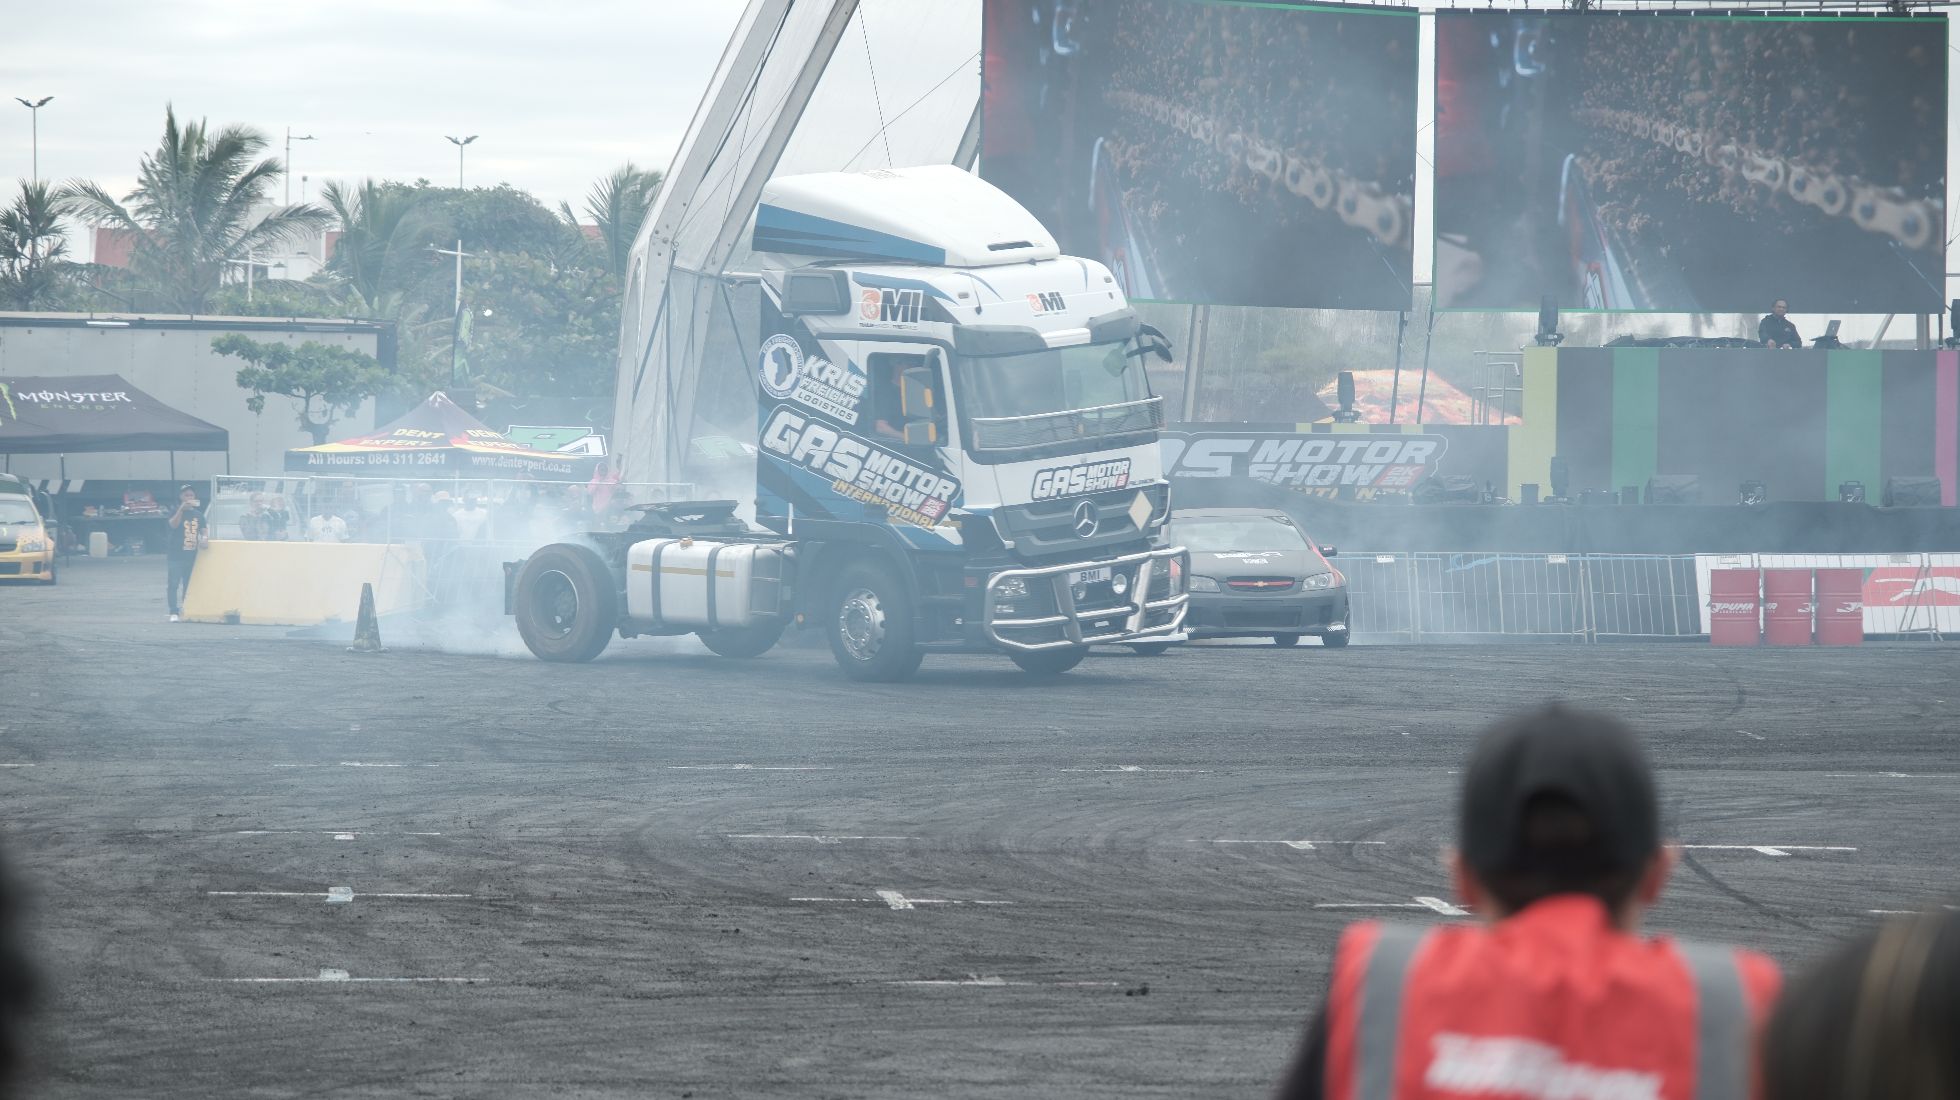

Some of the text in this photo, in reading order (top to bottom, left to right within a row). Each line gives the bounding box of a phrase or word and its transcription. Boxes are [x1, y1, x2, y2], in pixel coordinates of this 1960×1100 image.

[802, 354, 867, 398] KRIS
[18, 390, 132, 403] MONSTER
[798, 392, 853, 420] LOGISTICS
[393, 428, 445, 439] DENT
[763, 410, 871, 482] GAS
[1251, 439, 1438, 464] MOTOR
[308, 453, 446, 465] All Hours: 084 311 2641
[1086, 460, 1130, 479] MOTOR
[864, 449, 957, 503] MOTOR
[1033, 466, 1088, 499] GAS
[1085, 474, 1119, 491] SHOW
[1249, 464, 1384, 486] SHOW
[854, 469, 927, 512] SHOW
[1080, 568, 1101, 582] BMI
[1721, 602, 1754, 611] PUMA
